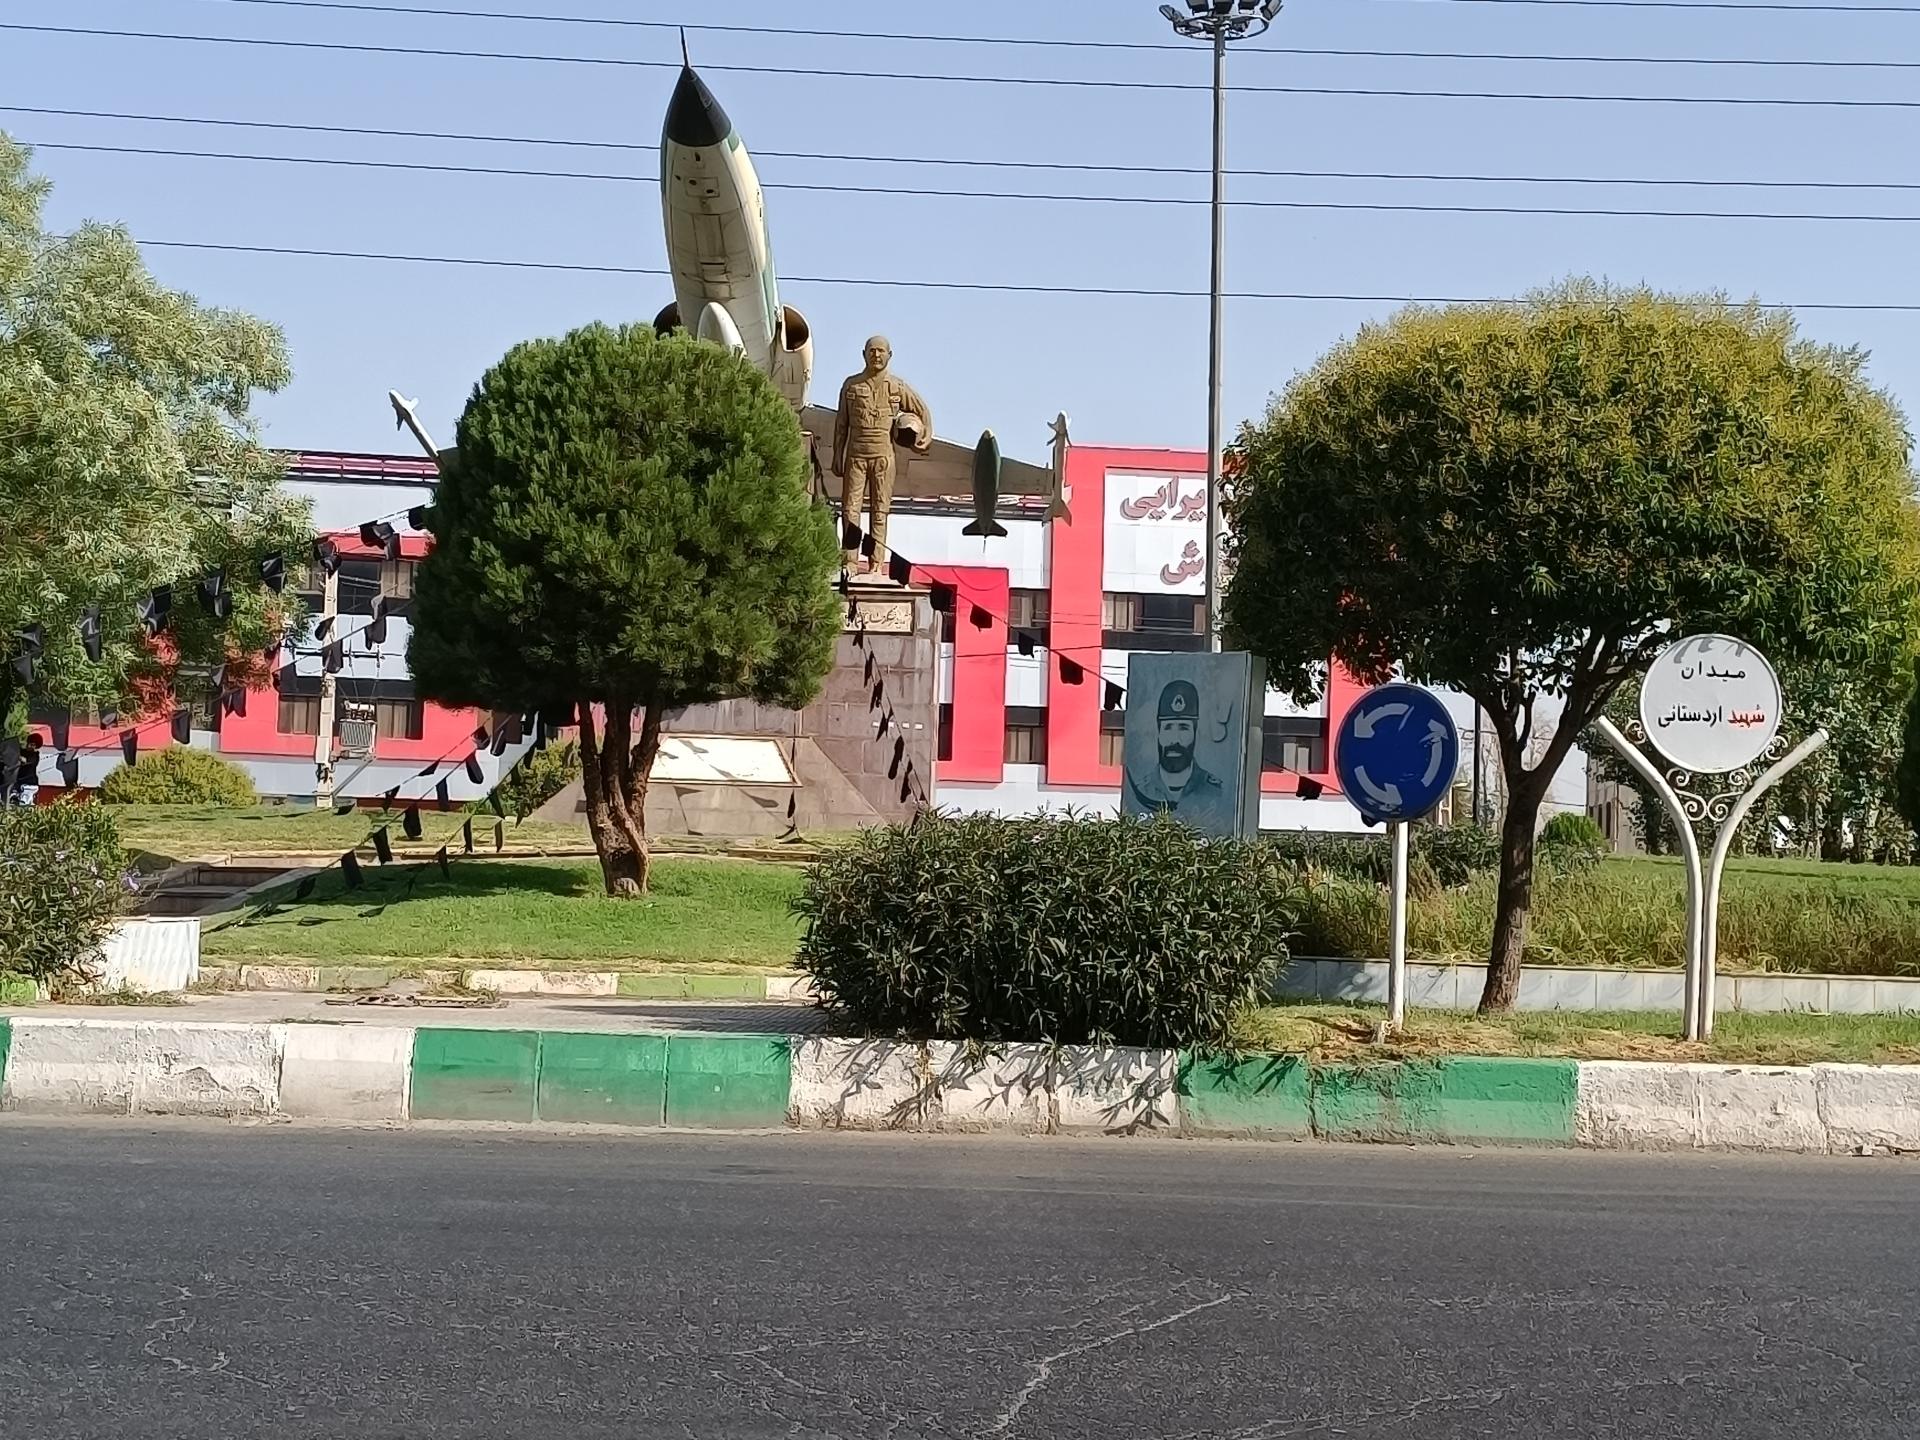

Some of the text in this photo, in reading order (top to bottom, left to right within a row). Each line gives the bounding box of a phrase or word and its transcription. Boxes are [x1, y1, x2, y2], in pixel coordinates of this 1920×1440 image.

[1120, 475, 1206, 522] یرایی
[1681, 660, 1746, 682] میدان
[1657, 703, 1765, 728] شهید اردستانی
